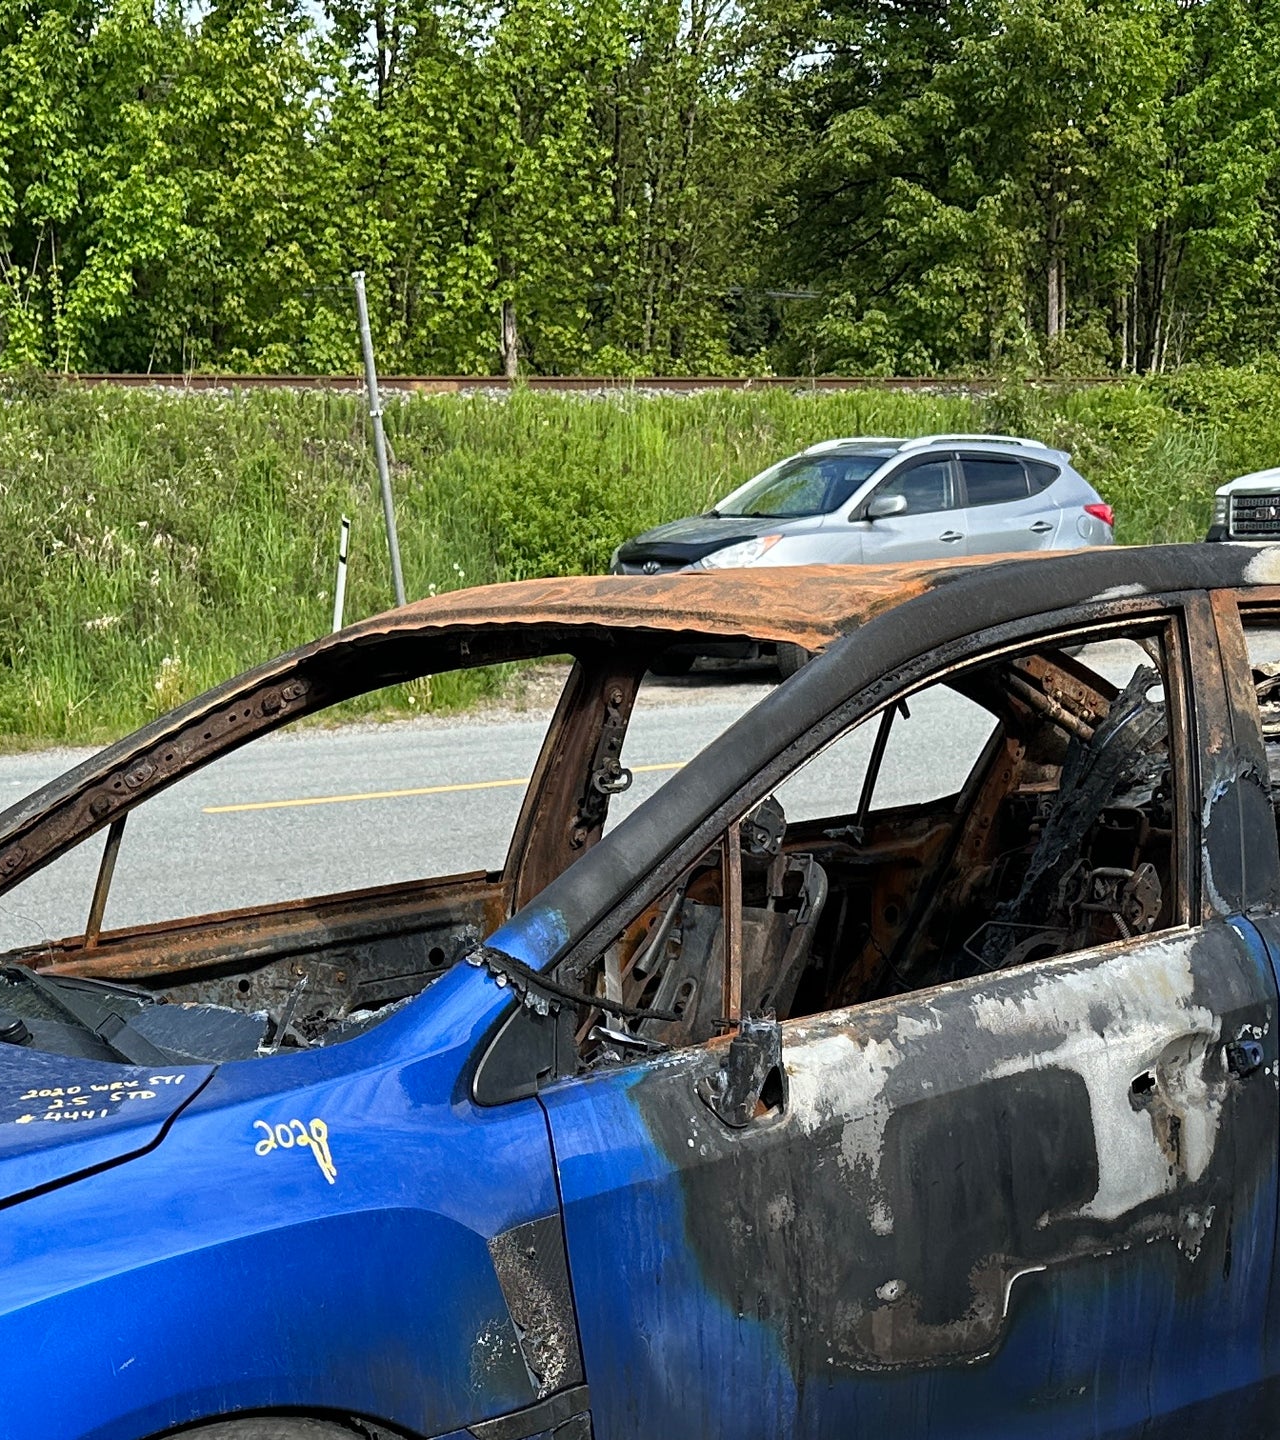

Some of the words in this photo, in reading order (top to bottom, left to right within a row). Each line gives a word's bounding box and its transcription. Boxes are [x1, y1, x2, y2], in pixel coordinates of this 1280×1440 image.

[20, 1086, 81, 1100] 2020
[149, 1074, 185, 1085] STI
[43, 1109, 108, 1121] 4441
